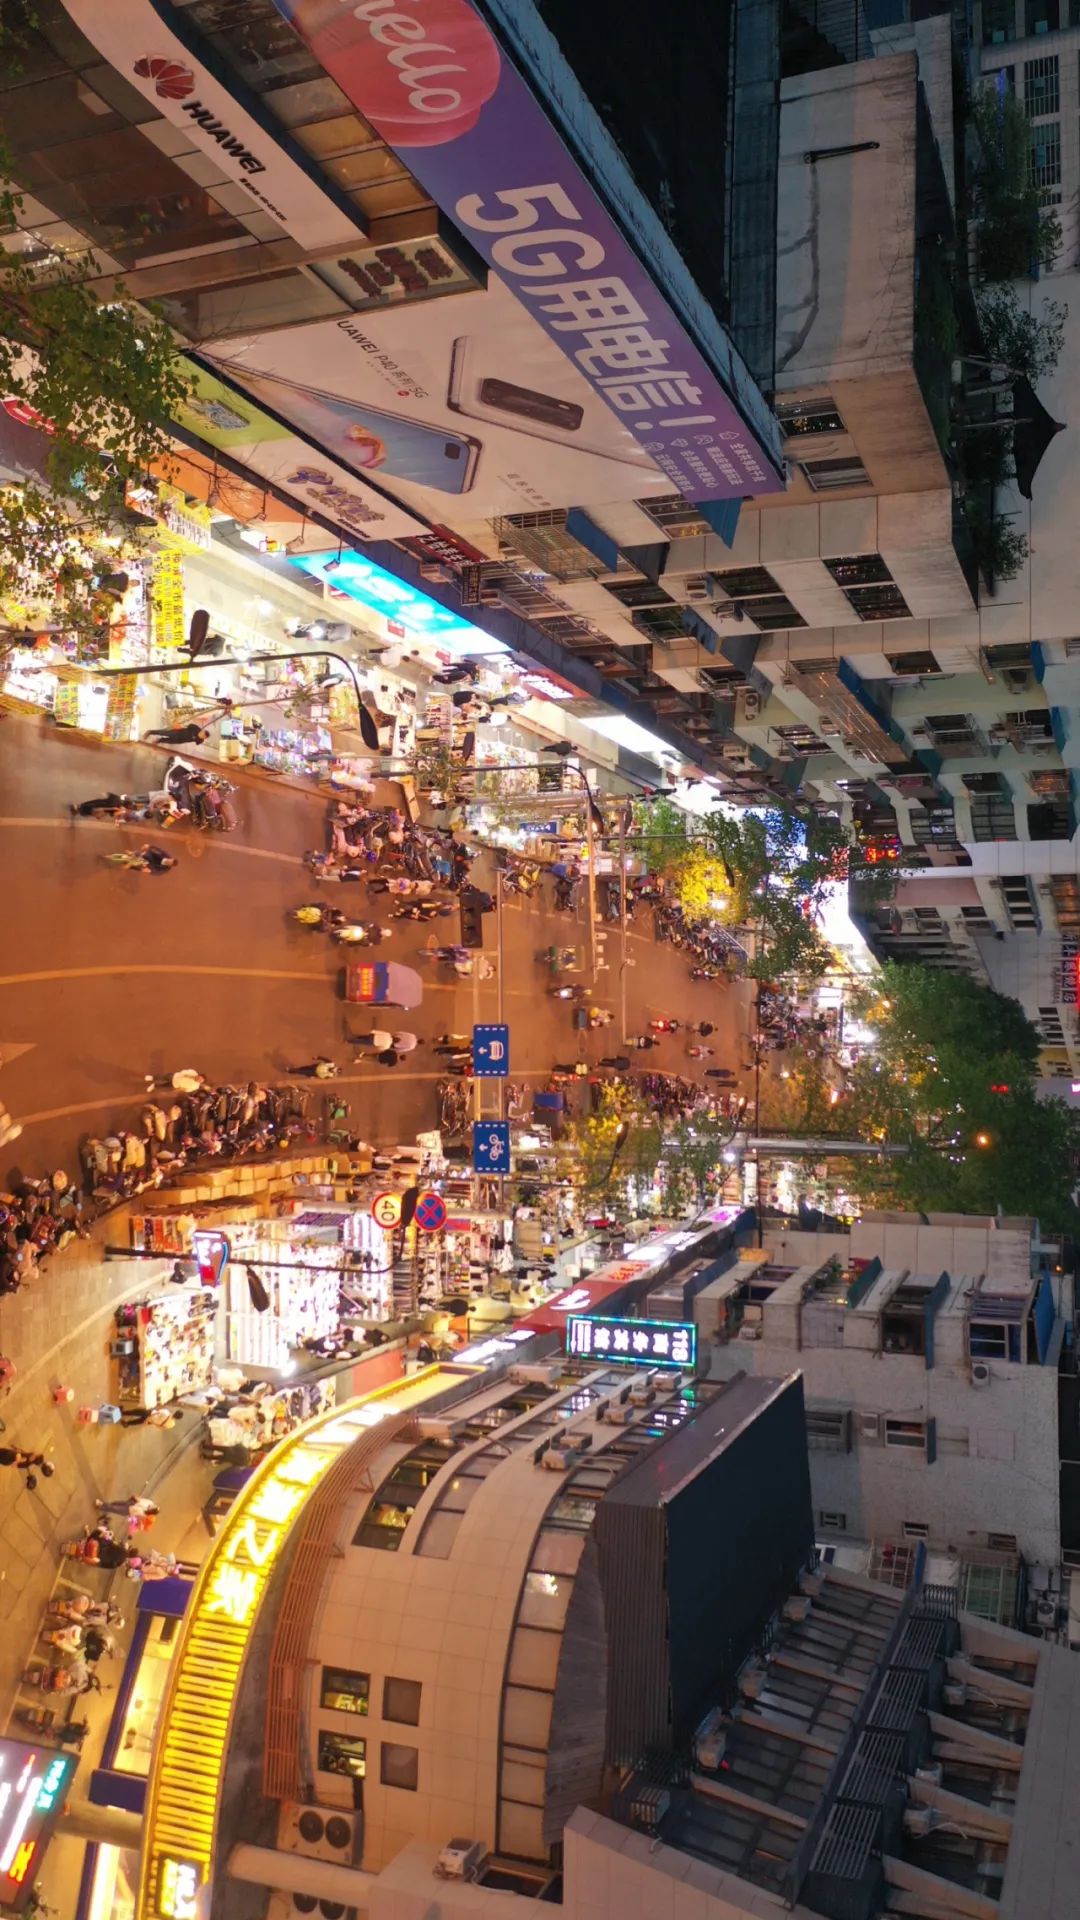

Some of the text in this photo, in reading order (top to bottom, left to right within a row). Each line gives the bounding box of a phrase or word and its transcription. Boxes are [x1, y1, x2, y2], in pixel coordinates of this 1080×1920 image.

[182, 100, 267, 174] HUAWEI
[455, 183, 716, 430] 5G用电信！
[374, 355, 398, 370] P40
[408, 387, 428, 398] 5G
[381, 1200, 395, 1222] 40
[672, 1329, 689, 1361] 118
